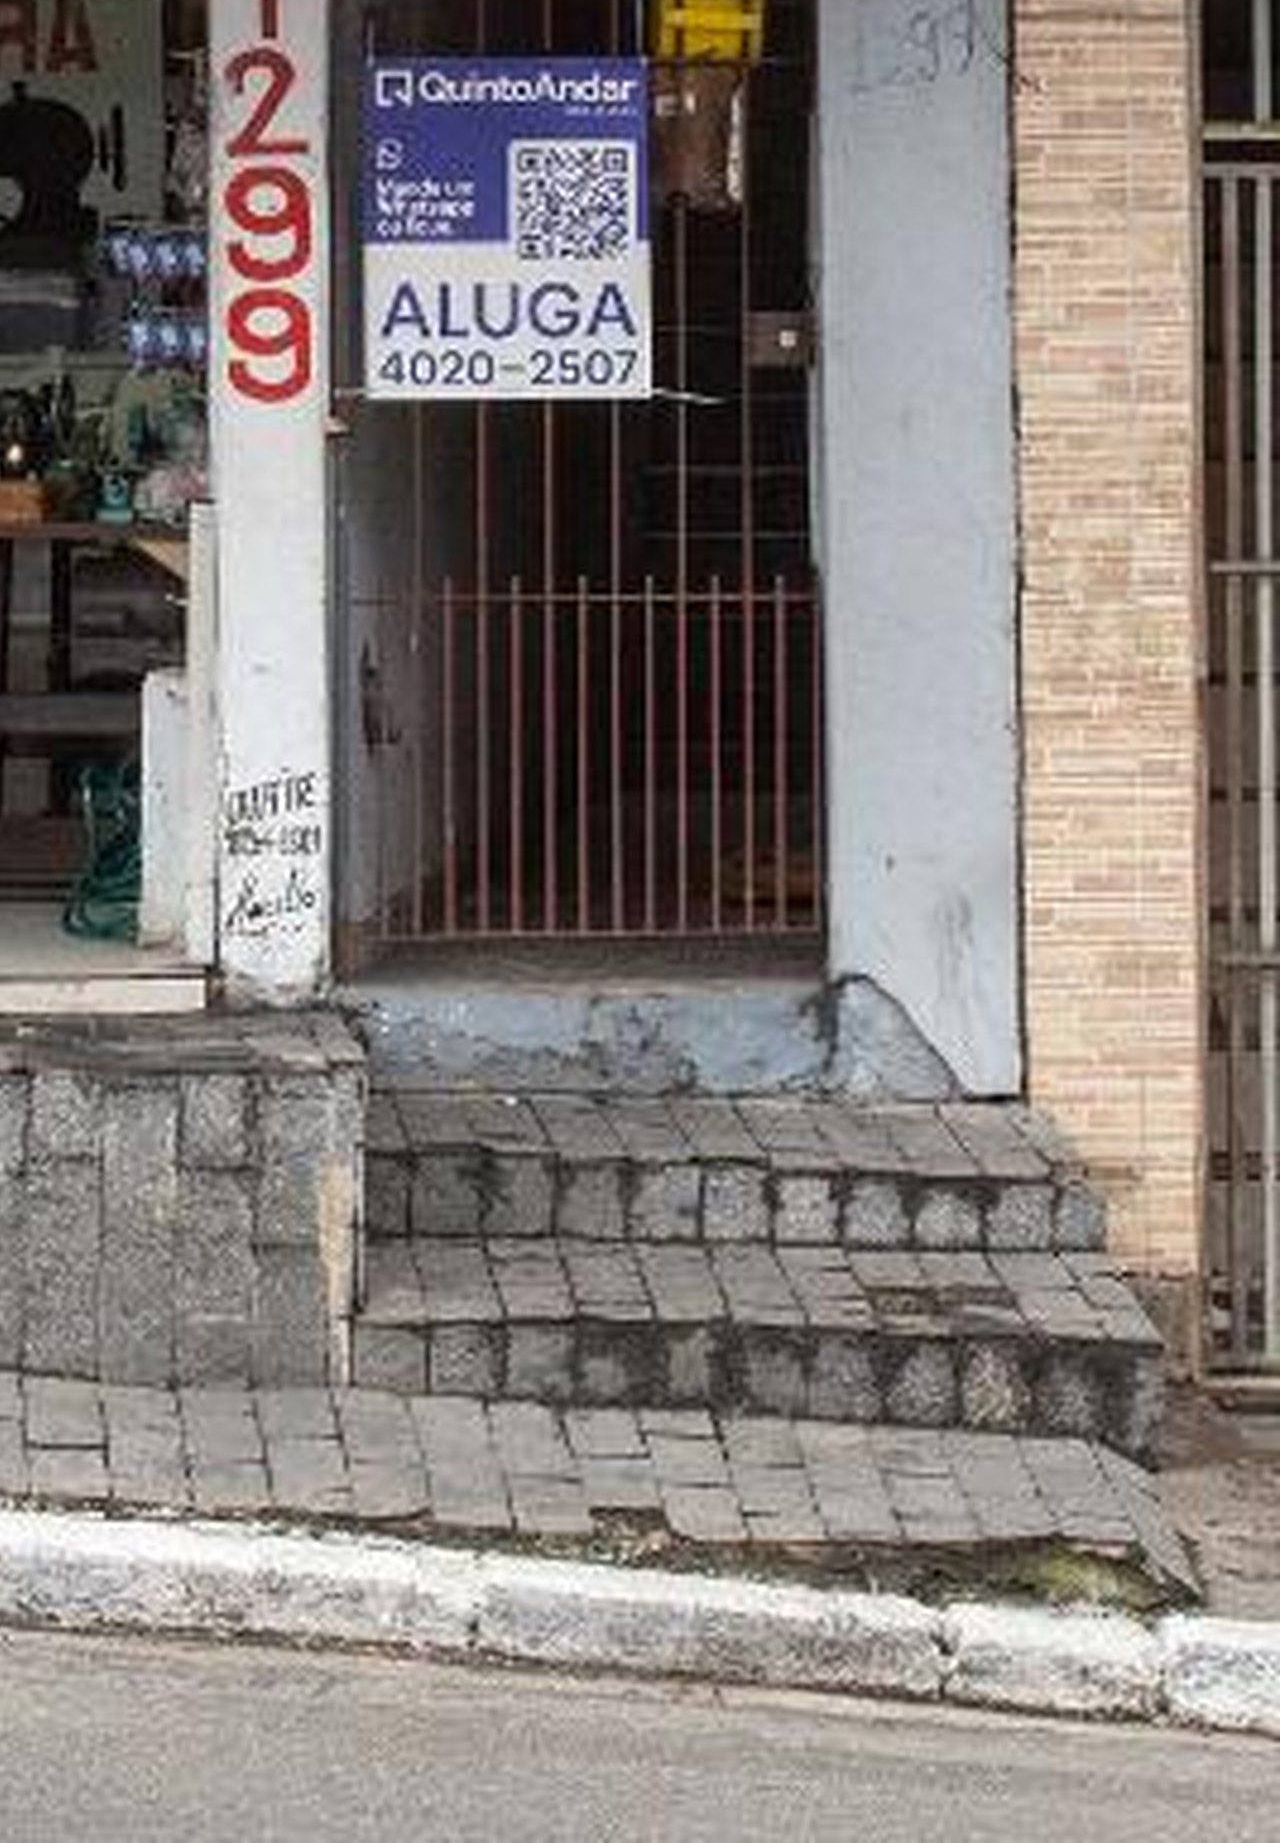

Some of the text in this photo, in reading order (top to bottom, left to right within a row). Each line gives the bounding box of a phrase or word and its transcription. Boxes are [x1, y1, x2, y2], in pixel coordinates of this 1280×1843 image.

[419, 70, 639, 105] QuintoAndar
[381, 281, 638, 339] ALUGA
[378, 349, 639, 386] 4020-2507
